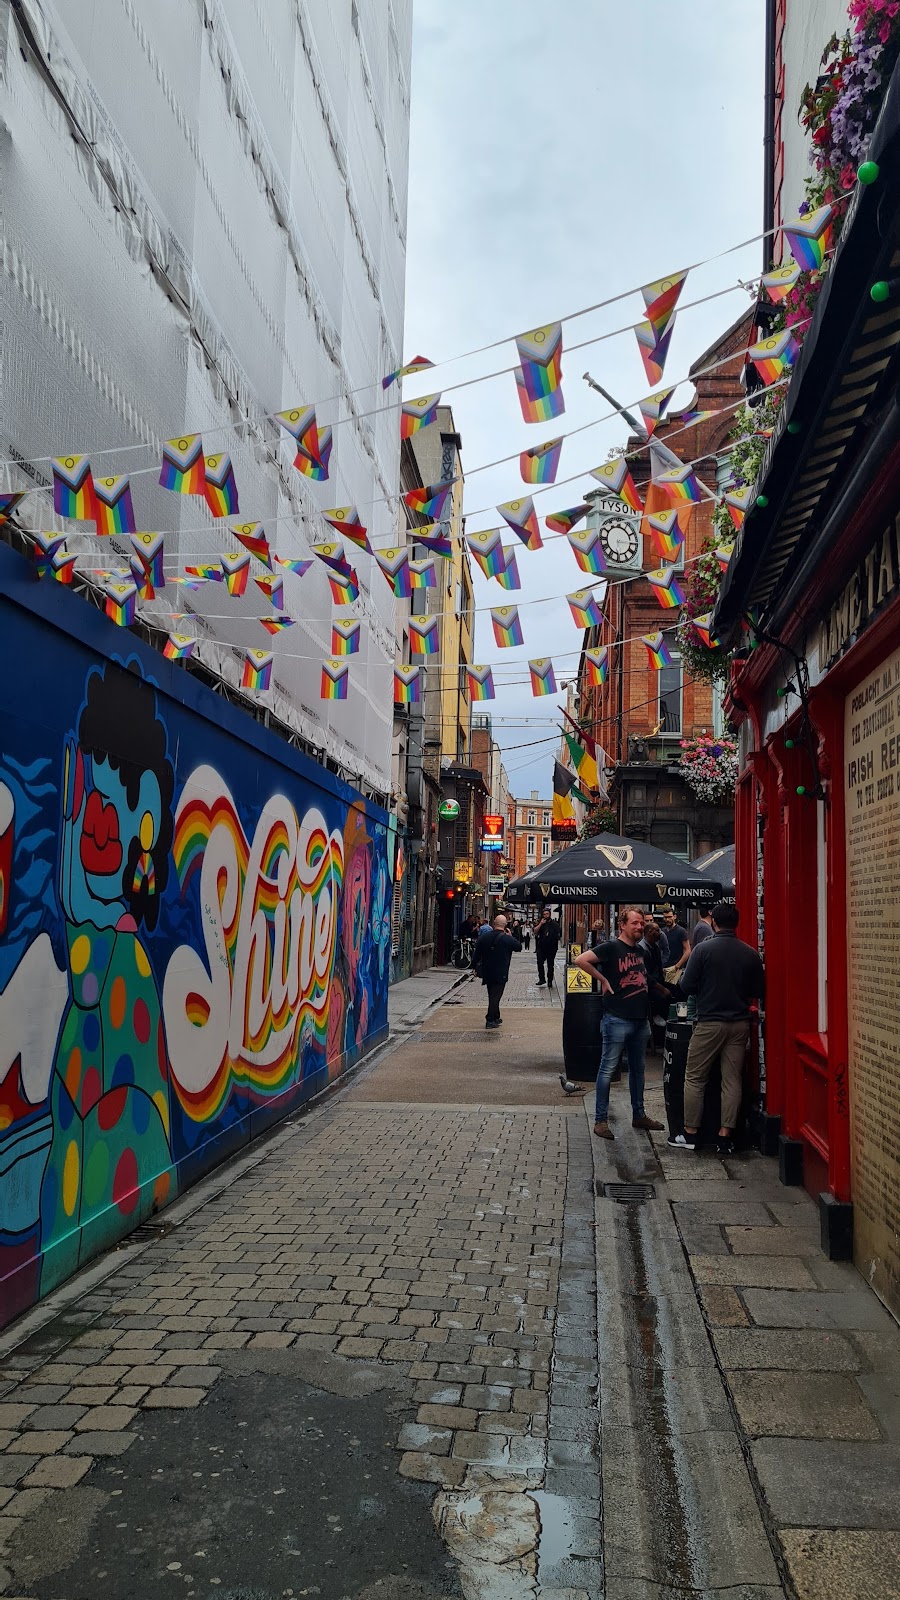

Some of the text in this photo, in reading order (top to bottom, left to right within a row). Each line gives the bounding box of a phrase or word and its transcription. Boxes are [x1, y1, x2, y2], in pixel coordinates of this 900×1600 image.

[848, 750, 874, 789] IRISH
[584, 868, 664, 878] GUINNESS
[551, 885, 598, 896] GUINNESS
[667, 886, 715, 898] GUINNESS
[162, 763, 344, 1094] Shine
